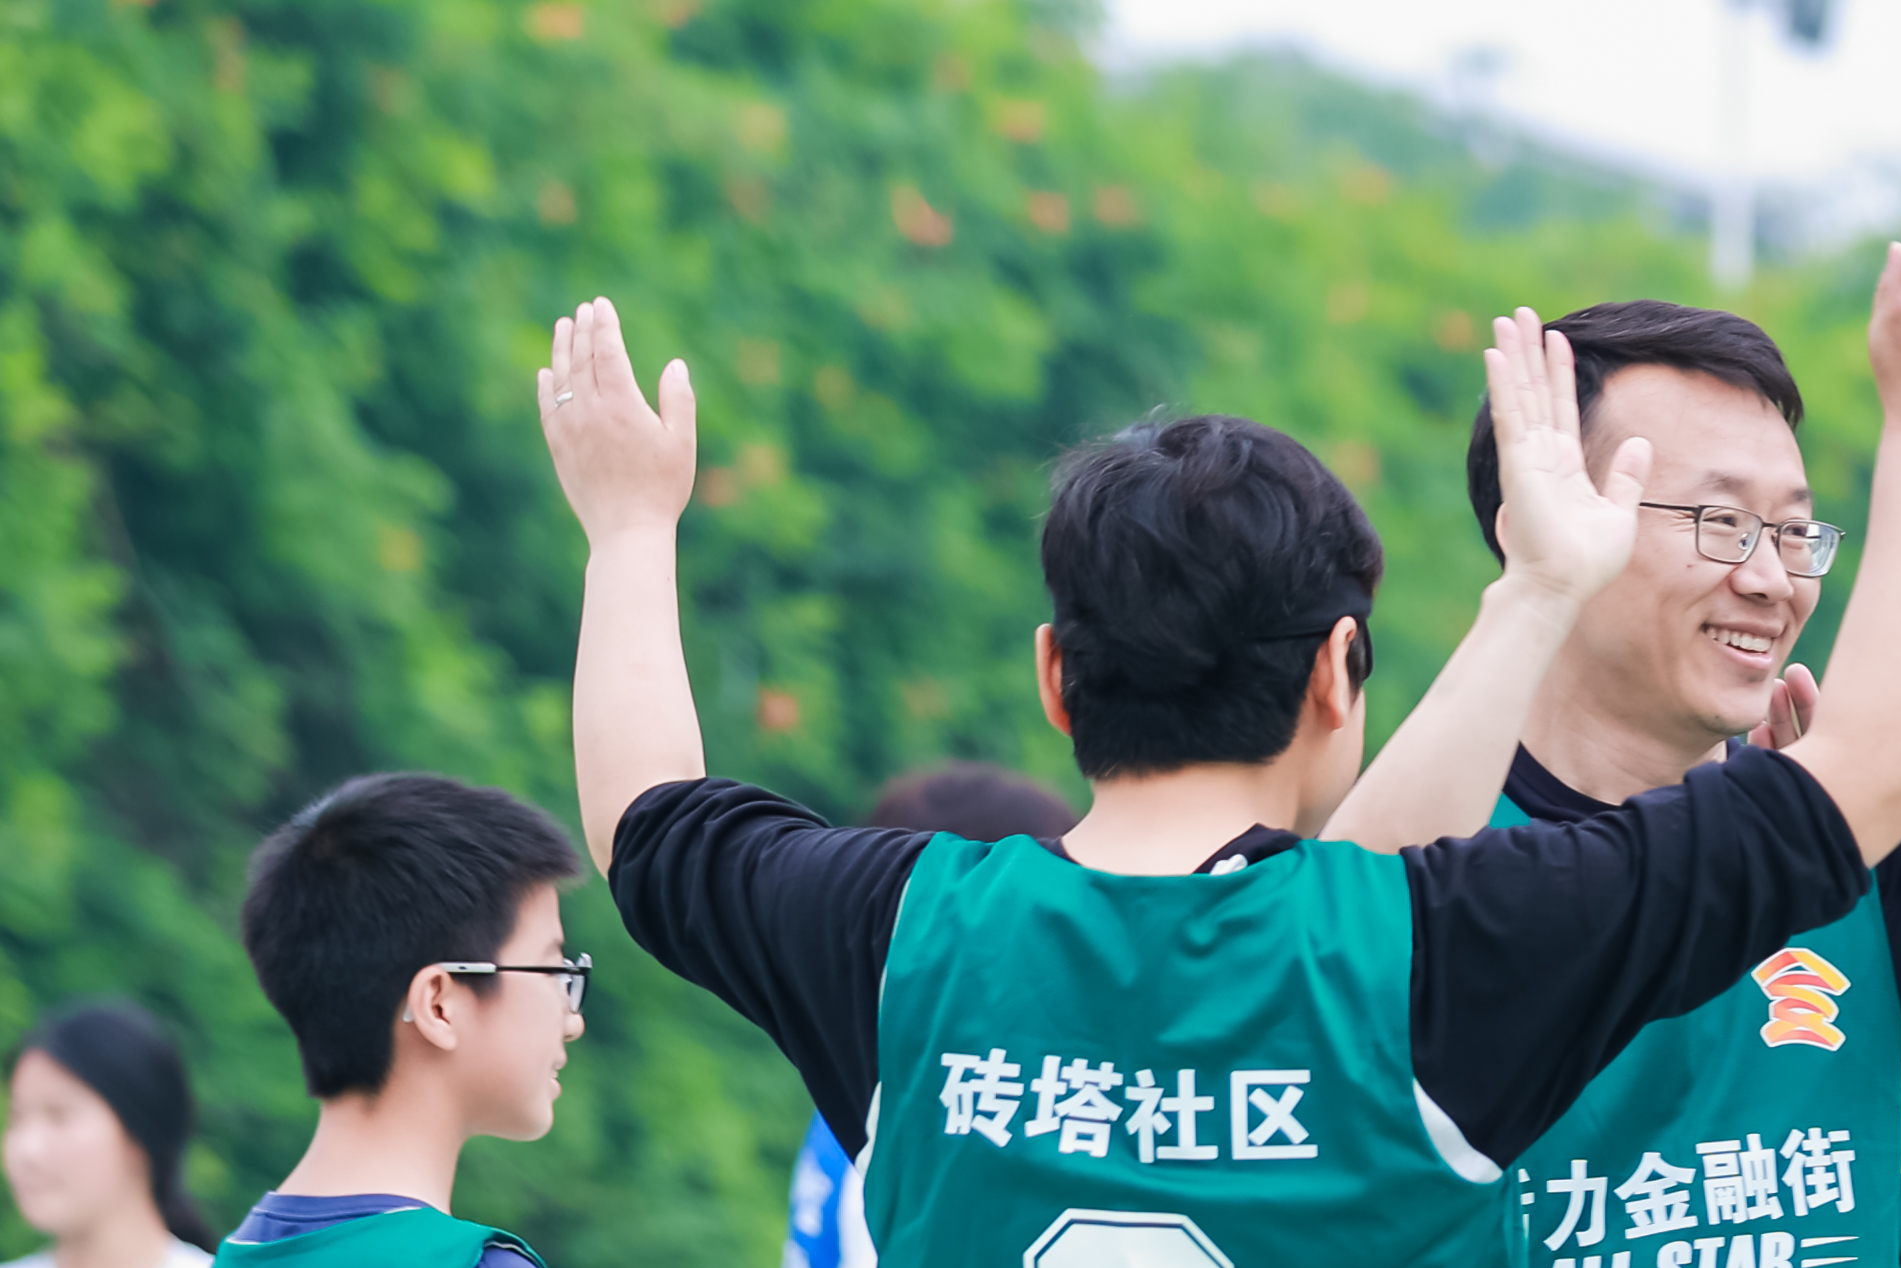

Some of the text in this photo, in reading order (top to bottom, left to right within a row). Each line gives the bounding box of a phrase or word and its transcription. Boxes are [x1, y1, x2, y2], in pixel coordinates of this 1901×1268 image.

[939, 1048, 1318, 1164] 砖塔社区
[1518, 1127, 1856, 1251] 力金融街
